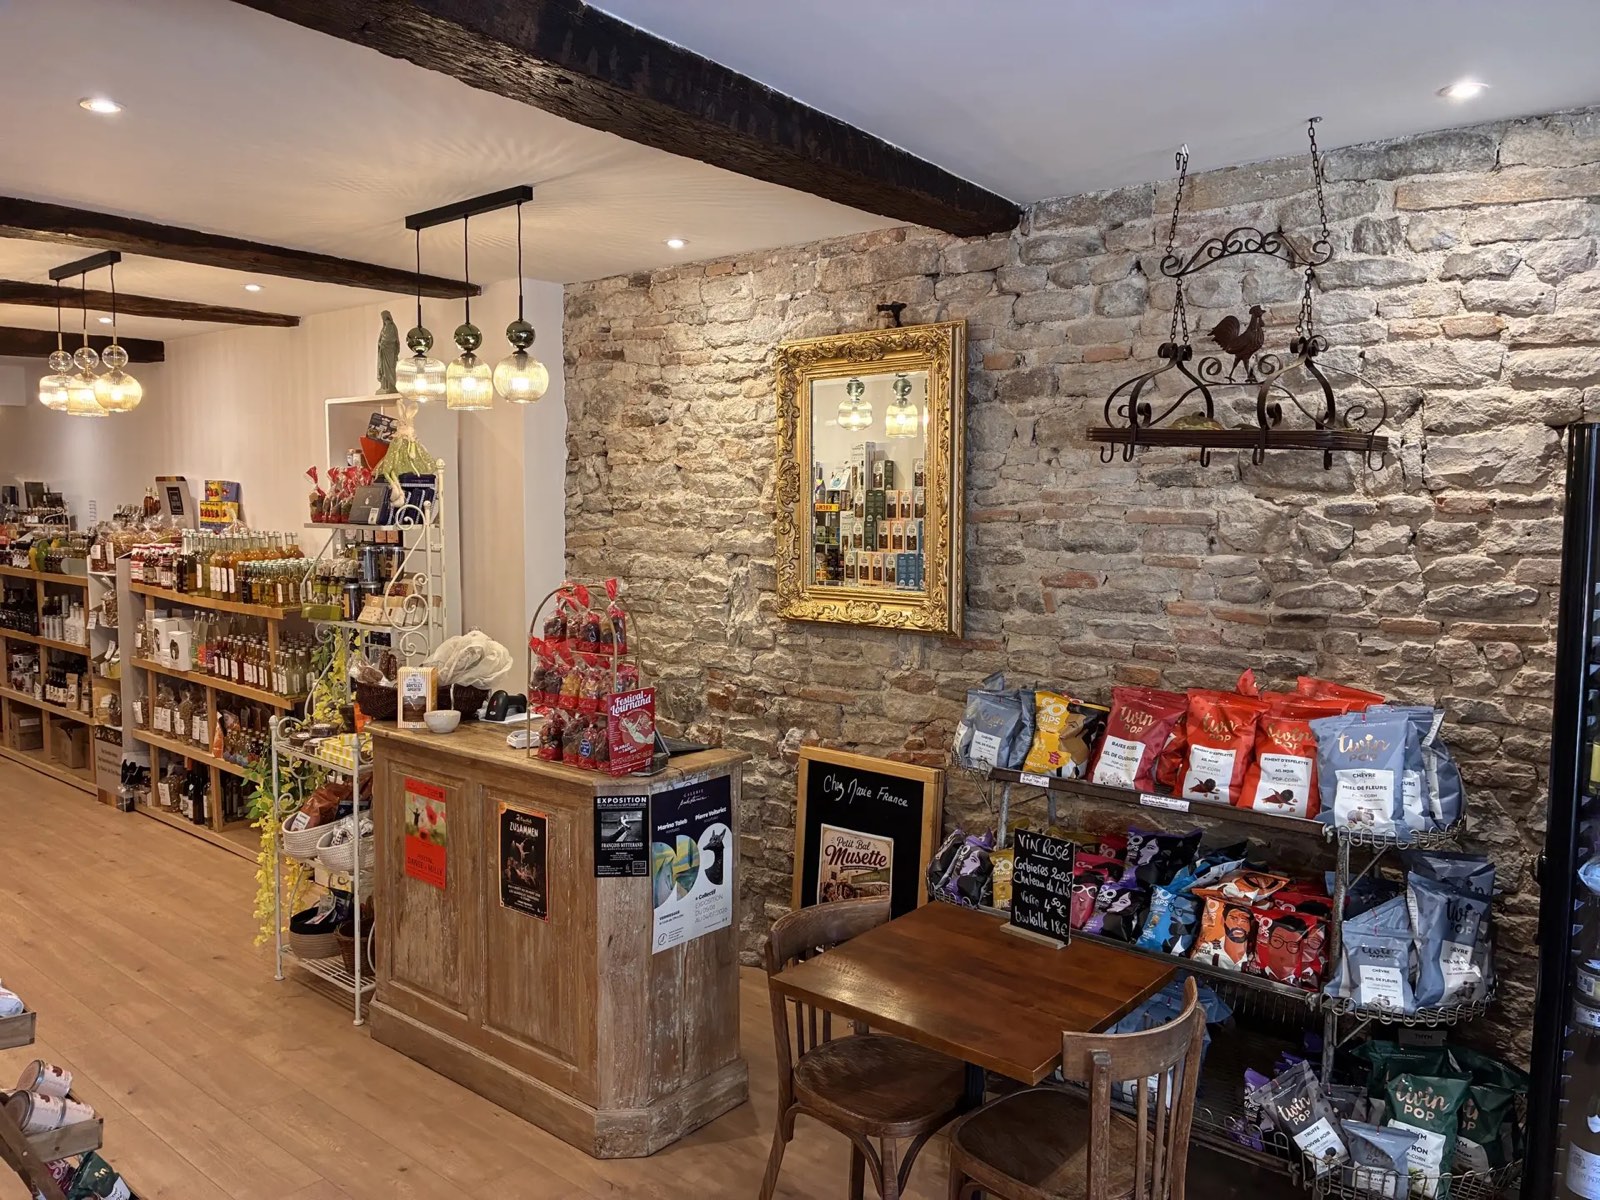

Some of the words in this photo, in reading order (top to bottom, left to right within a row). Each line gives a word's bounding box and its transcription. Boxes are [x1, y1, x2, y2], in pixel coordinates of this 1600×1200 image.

[610, 694, 652, 717] Lournand
[614, 690, 644, 705] Festival
[1124, 724, 1143, 734] POP
[1337, 732, 1390, 753] twin
[1352, 771, 1376, 779] CHÈVRE
[823, 773, 845, 801] Chez
[848, 778, 872, 804] Marie
[877, 786, 908, 807] France
[509, 821, 539, 838] ZUSAMMEN
[836, 836, 854, 848] Petit
[855, 840, 871, 851] Bal
[825, 844, 887, 867] Musette
[1277, 1097, 1311, 1121] twin
[1292, 1109, 1311, 1125] POP
[1404, 1104, 1435, 1121] POP
[1304, 1125, 1320, 1138] TRUFFE
[1304, 1138, 1320, 1150] POIVRE
[1320, 1131, 1331, 1140] NOIR
